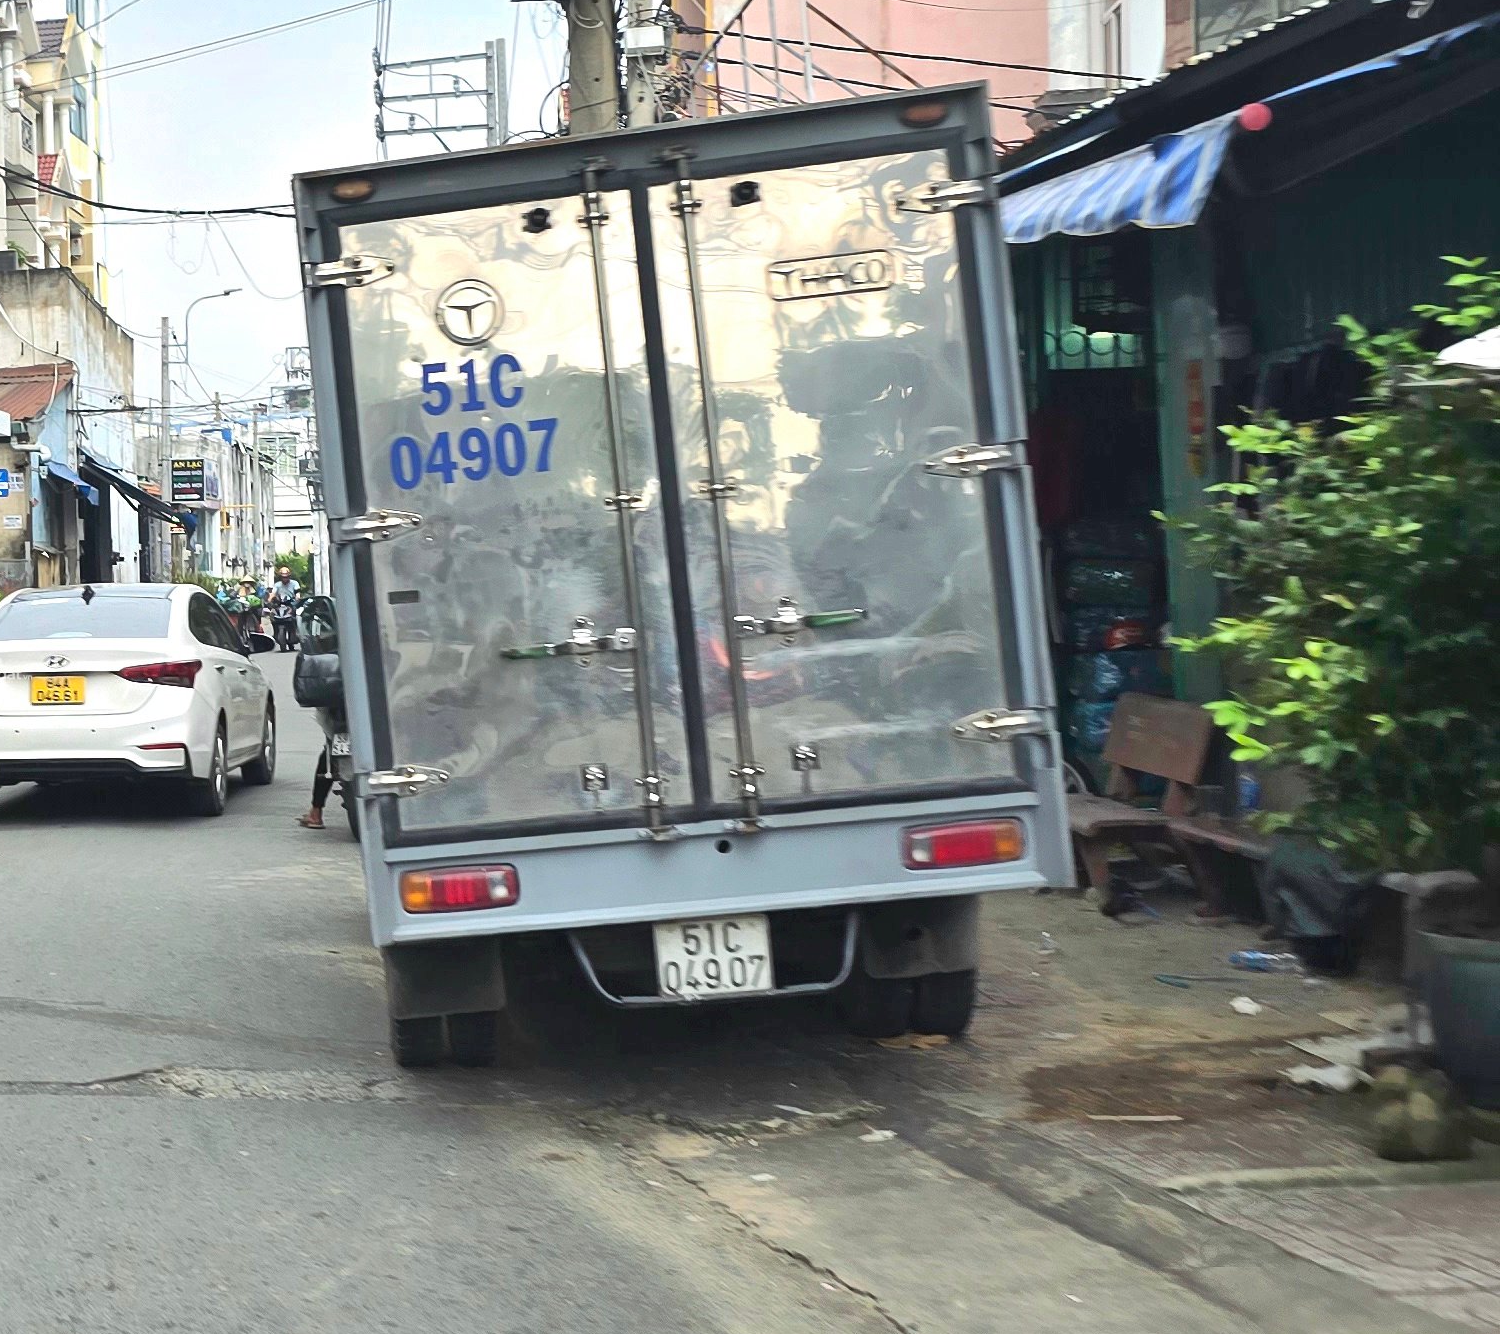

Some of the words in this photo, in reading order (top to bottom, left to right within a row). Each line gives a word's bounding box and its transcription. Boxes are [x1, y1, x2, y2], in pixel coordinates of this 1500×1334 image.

[421, 353, 525, 416] 51C
[389, 417, 558, 490] 04907
[681, 921, 742, 956] 51C
[663, 954, 766, 992] 049.07
